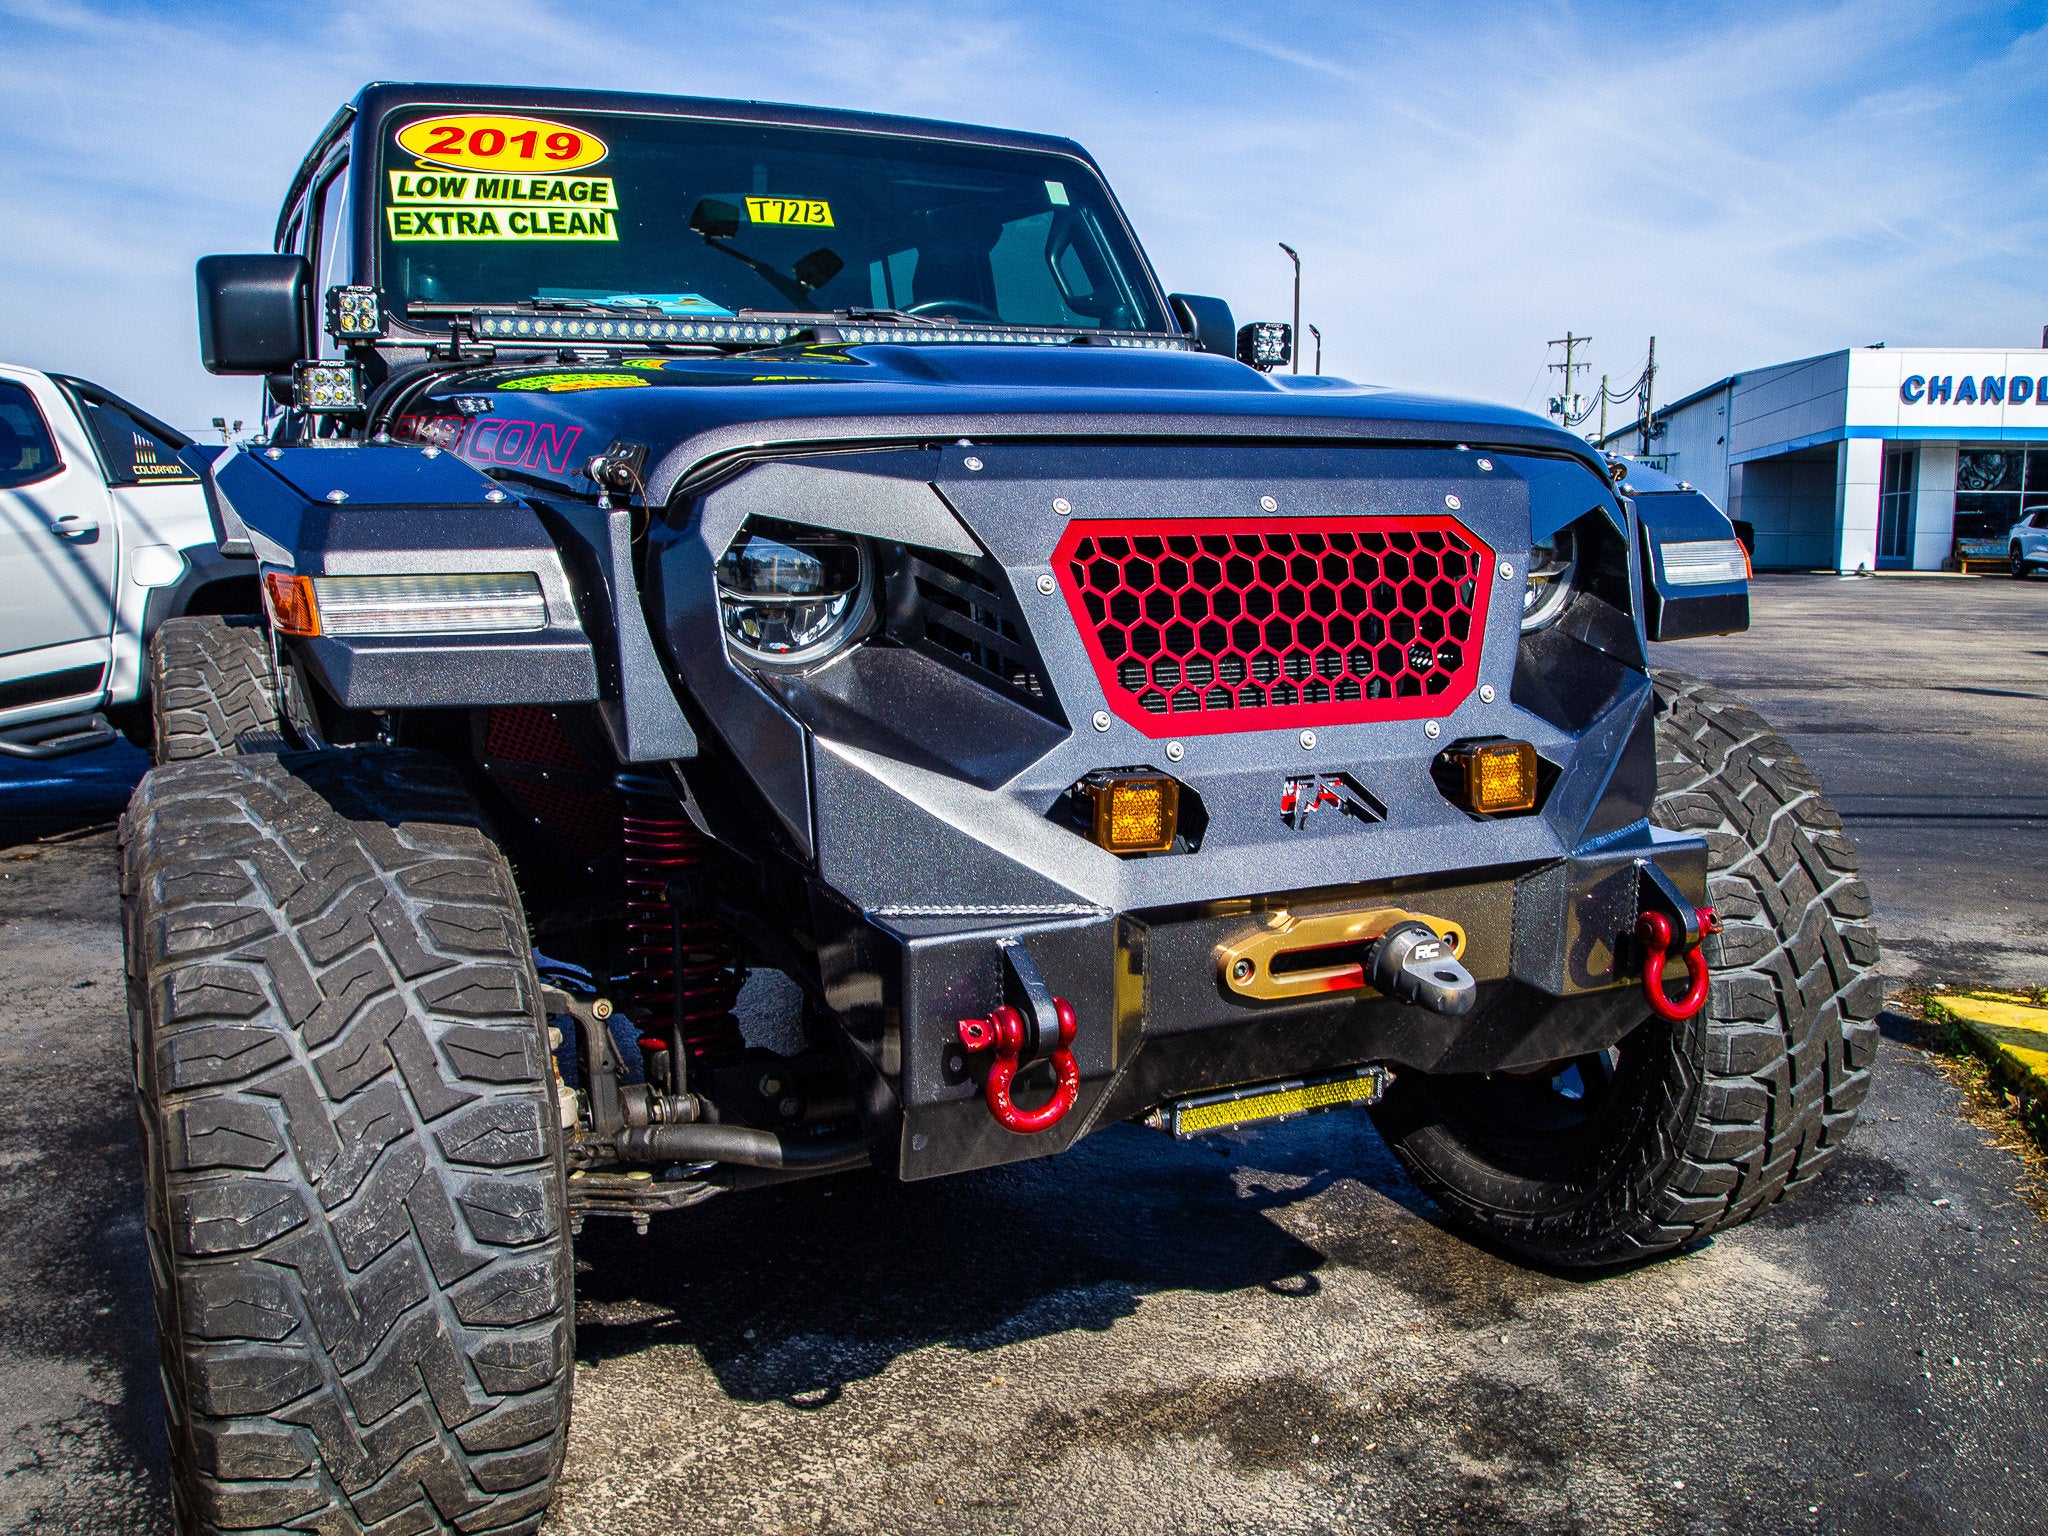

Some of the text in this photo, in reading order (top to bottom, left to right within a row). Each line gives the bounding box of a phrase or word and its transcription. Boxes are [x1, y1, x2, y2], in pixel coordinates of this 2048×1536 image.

[424, 126, 583, 161] 2019
[397, 175, 609, 203] LOW MILEAGE
[393, 211, 610, 237] EXTRA CLEAN
[750, 200, 826, 224] T7213
[132, 465, 182, 475] COLORADO
[1415, 942, 1440, 960] RC
